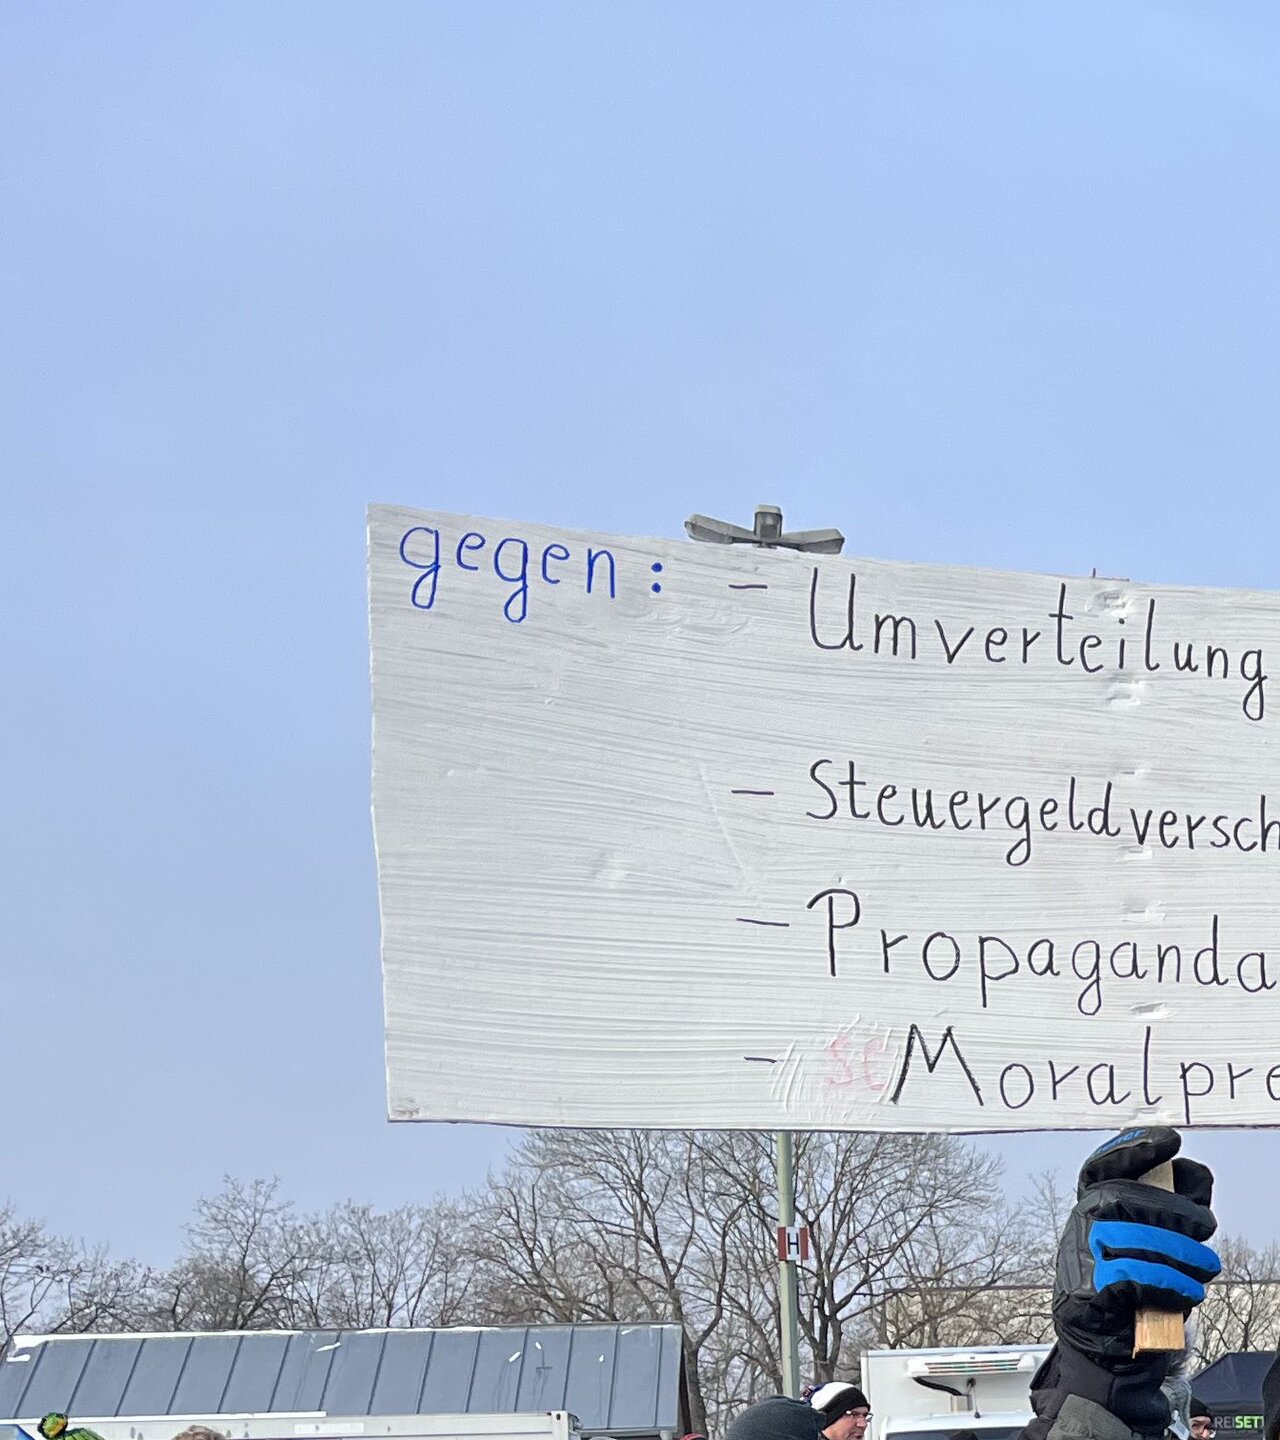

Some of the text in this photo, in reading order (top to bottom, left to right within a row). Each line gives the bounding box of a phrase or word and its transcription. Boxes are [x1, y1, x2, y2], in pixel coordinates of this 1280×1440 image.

[400, 526, 664, 623] gegen:
[808, 566, 1269, 721] Umverteilung
[806, 888, 1277, 1016] Propaganda
[787, 1231, 799, 1255] H
